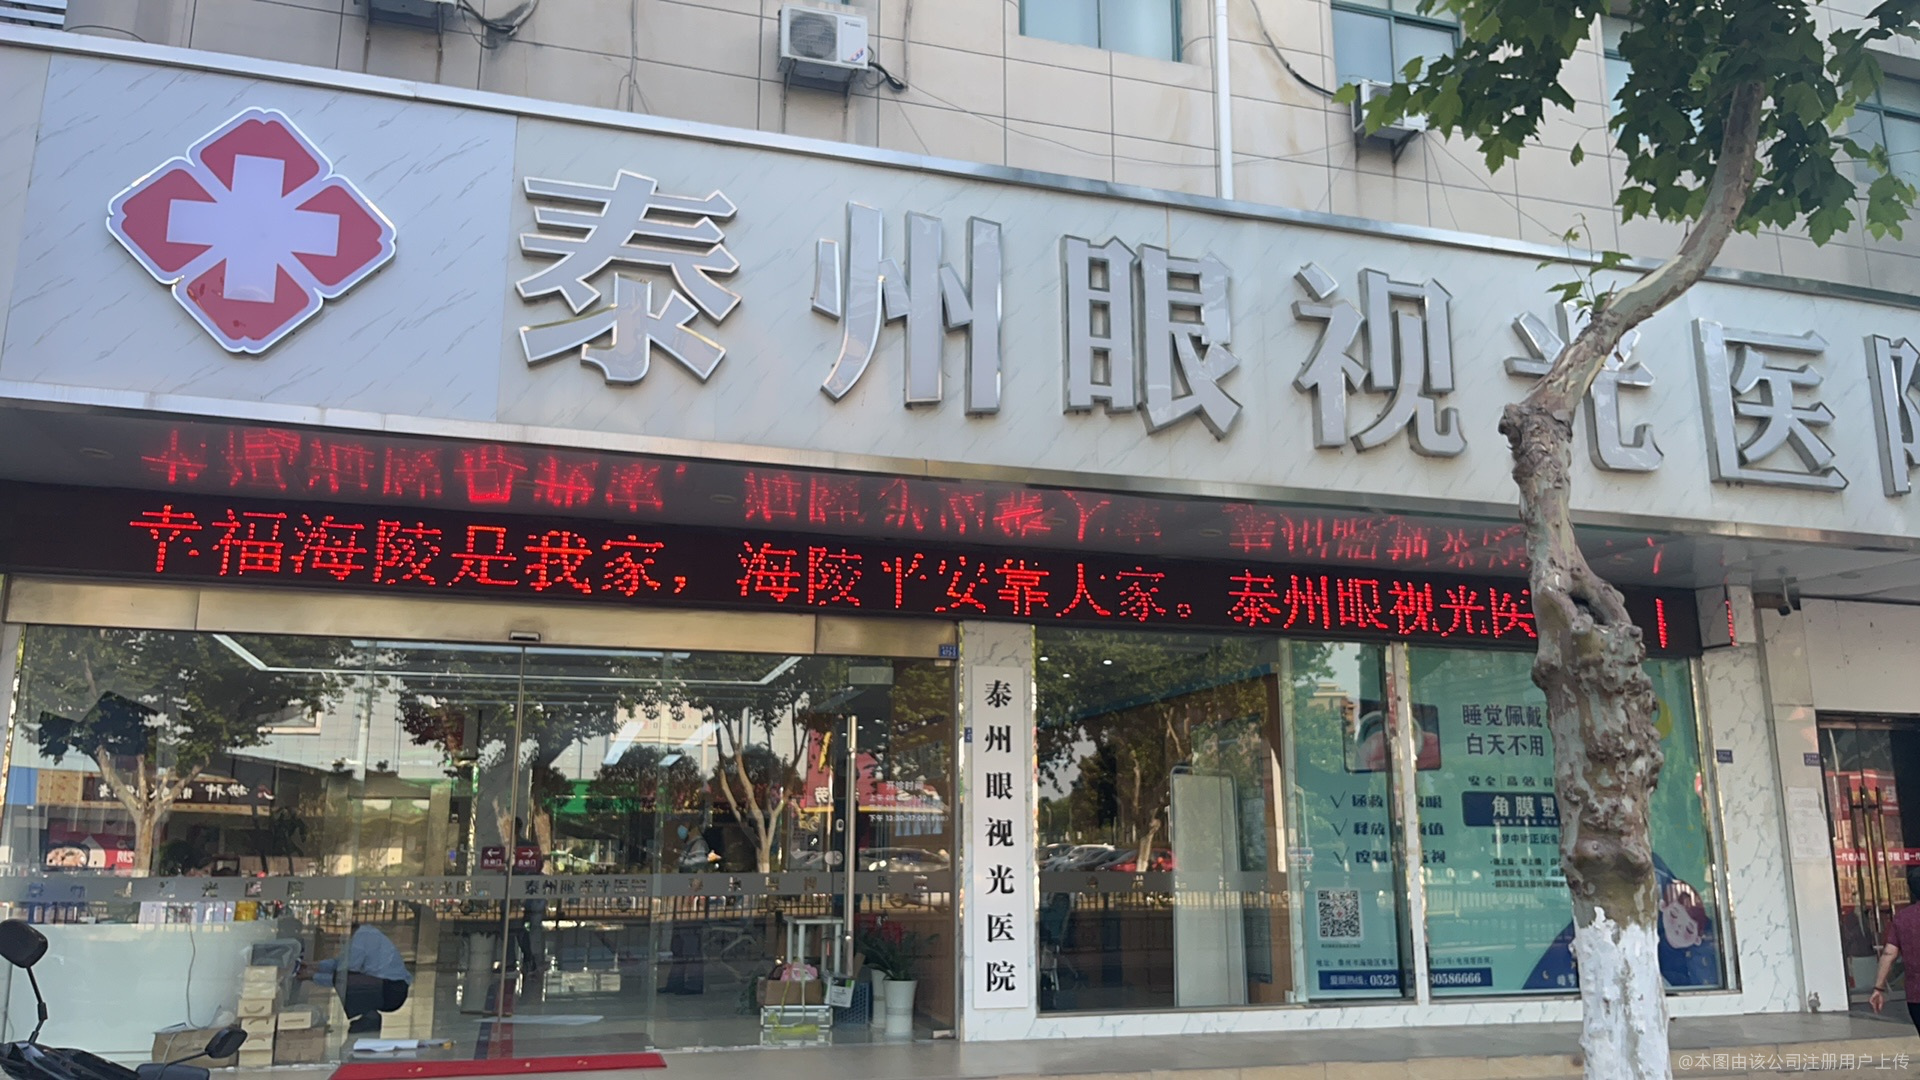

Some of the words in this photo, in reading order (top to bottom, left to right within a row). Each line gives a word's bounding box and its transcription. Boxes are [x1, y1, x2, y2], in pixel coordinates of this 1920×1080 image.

[1462, 704, 1543, 728] 睡觉佩戴
[1467, 733, 1544, 757] 白天不用
[1492, 795, 1556, 817] 角膜塑
[984, 680, 1016, 993] 泰州眼视光医院
